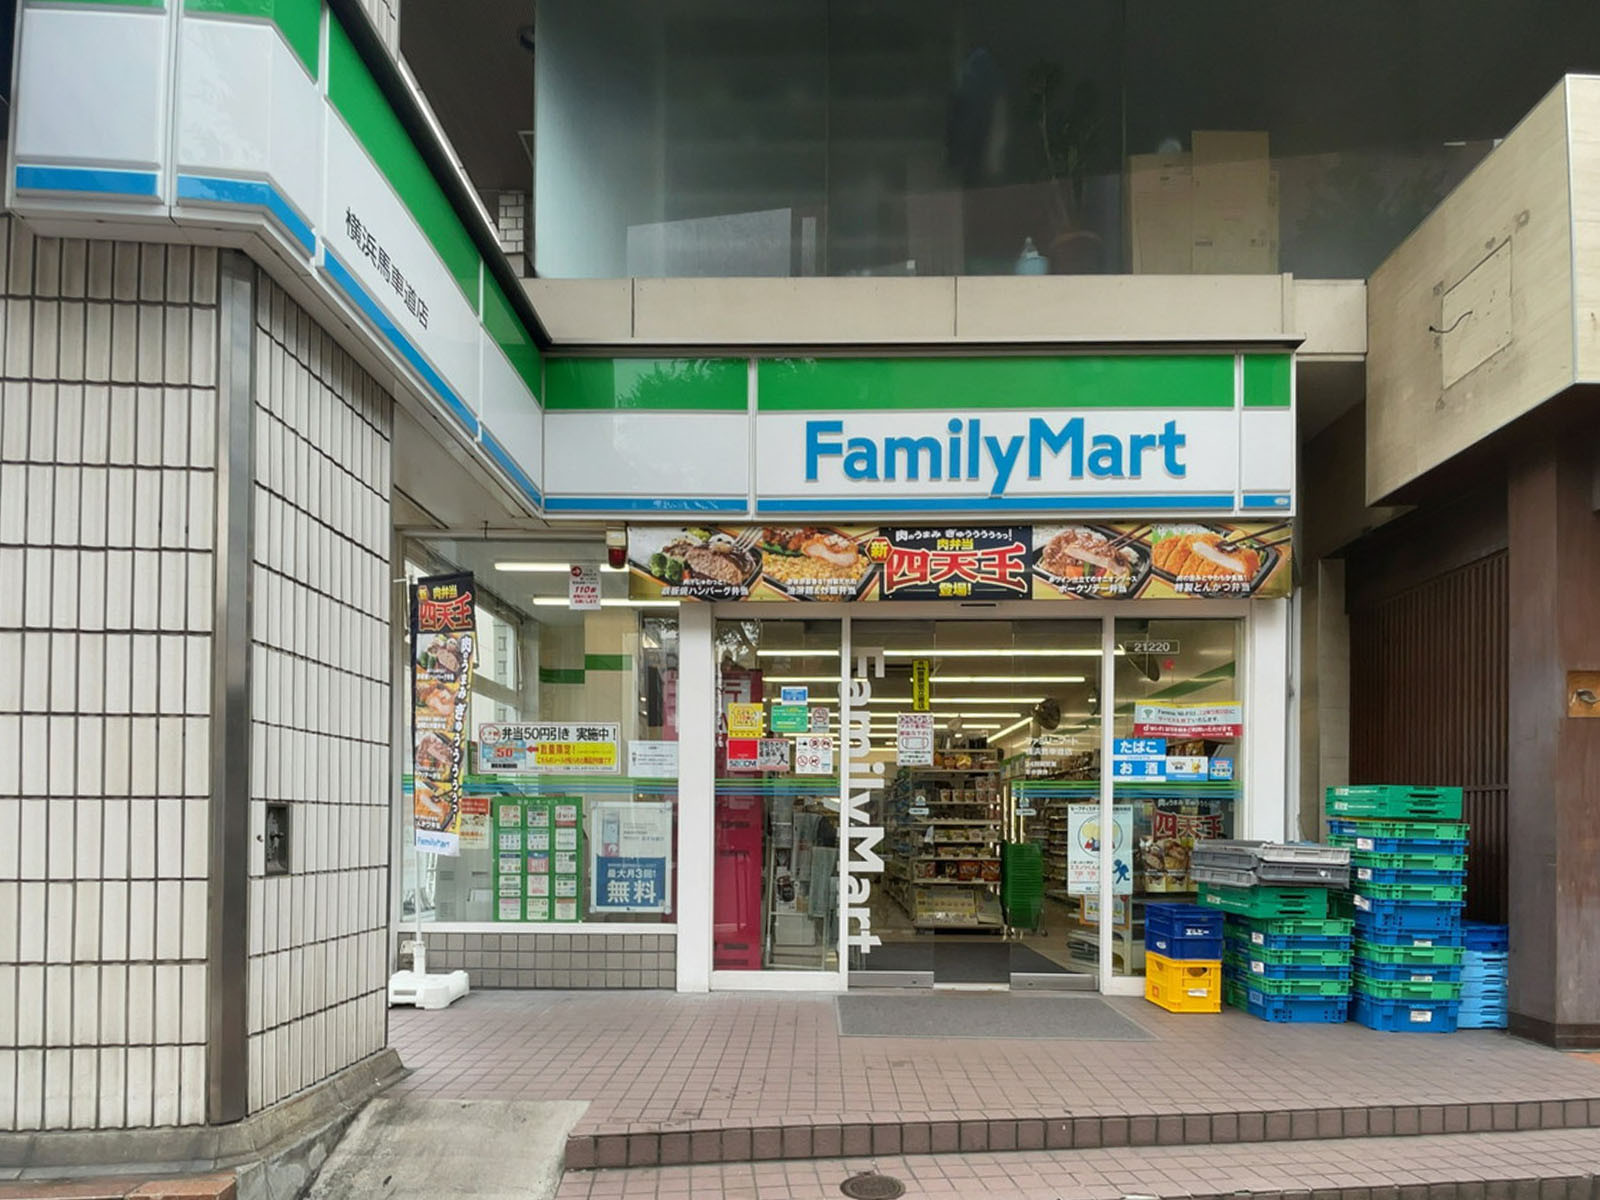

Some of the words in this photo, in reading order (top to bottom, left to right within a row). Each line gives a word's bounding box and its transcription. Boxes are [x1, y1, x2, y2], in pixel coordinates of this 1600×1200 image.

[346, 207, 429, 330] 横浜馬車道店
[805, 418, 1187, 500] FamilyMart
[870, 542, 889, 558] 新
[937, 539, 974, 550] 肉弁当
[885, 542, 1028, 594] 四天王
[419, 592, 472, 631] 四天王
[1134, 642, 1170, 652] 21220
[502, 727, 570, 740] 弁当50円引き
[576, 727, 616, 740] 実施中！
[1120, 741, 1158, 754] たばこ
[1152, 809, 1224, 841] 四天王
[607, 880, 656, 904] 無料
